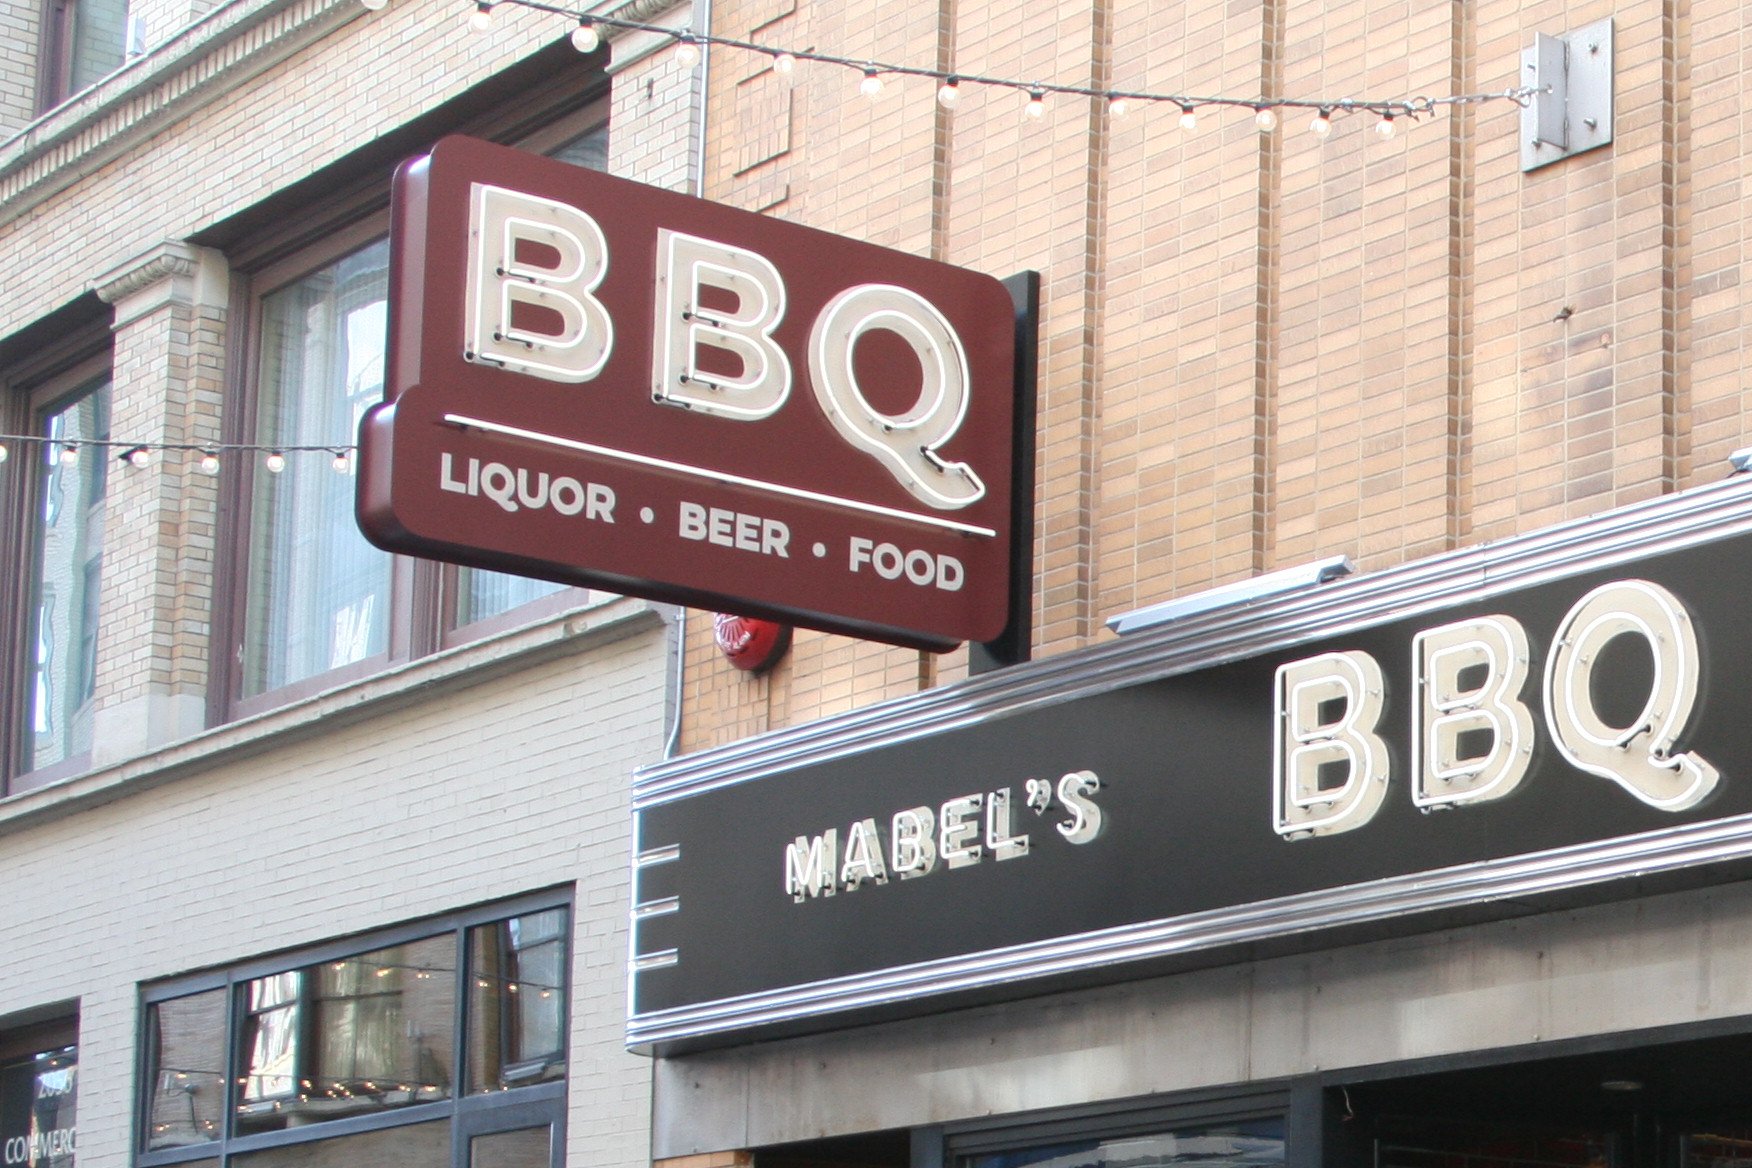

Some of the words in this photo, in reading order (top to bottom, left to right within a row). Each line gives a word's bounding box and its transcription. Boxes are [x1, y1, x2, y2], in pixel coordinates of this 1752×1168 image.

[463, 181, 986, 510] BBQ
[440, 452, 615, 524] LIQUOR
[679, 501, 789, 558] BEER
[849, 537, 964, 591] FOOD
[786, 769, 1101, 904] MABEL'S
[1273, 578, 1720, 841] BBQ
